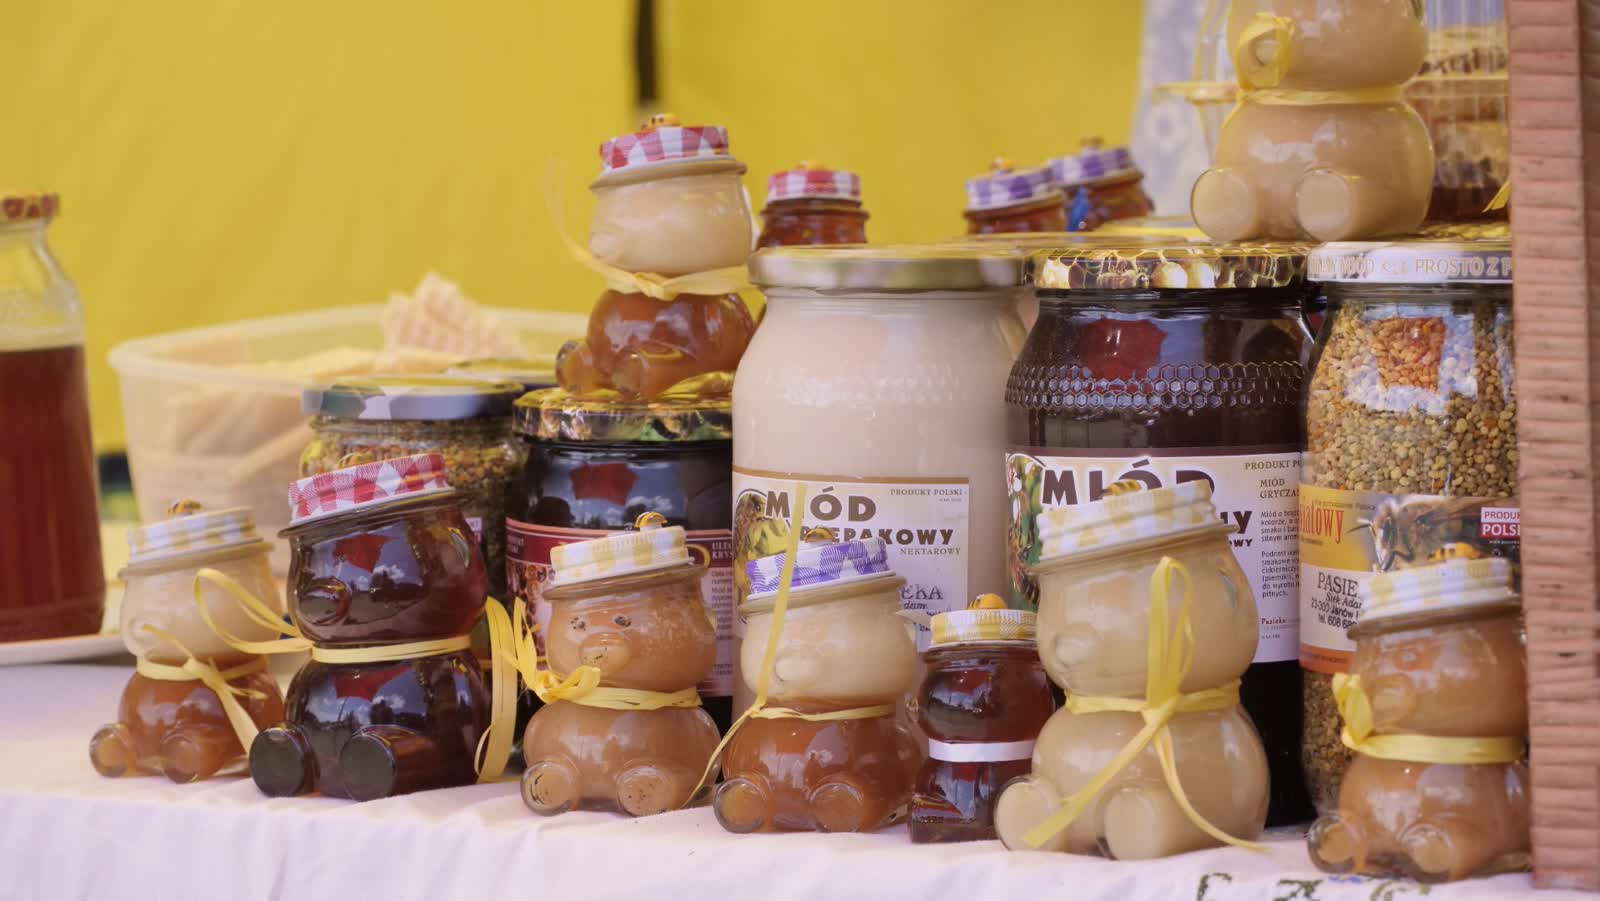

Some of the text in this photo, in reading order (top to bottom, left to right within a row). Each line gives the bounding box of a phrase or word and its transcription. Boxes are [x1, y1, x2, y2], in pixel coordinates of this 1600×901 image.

[1415, 256, 1484, 276] PROSTO
[1244, 460, 1290, 470] PRODUKT
[1260, 478, 1285, 487] MIÓD
[890, 488, 963, 496] PRODUKT POLSKI
[765, 486, 877, 522] MÓD
[800, 526, 954, 546] EPAKOWY
[900, 547, 961, 556] NEKTAROWY
[1317, 571, 1360, 598] PASIE
